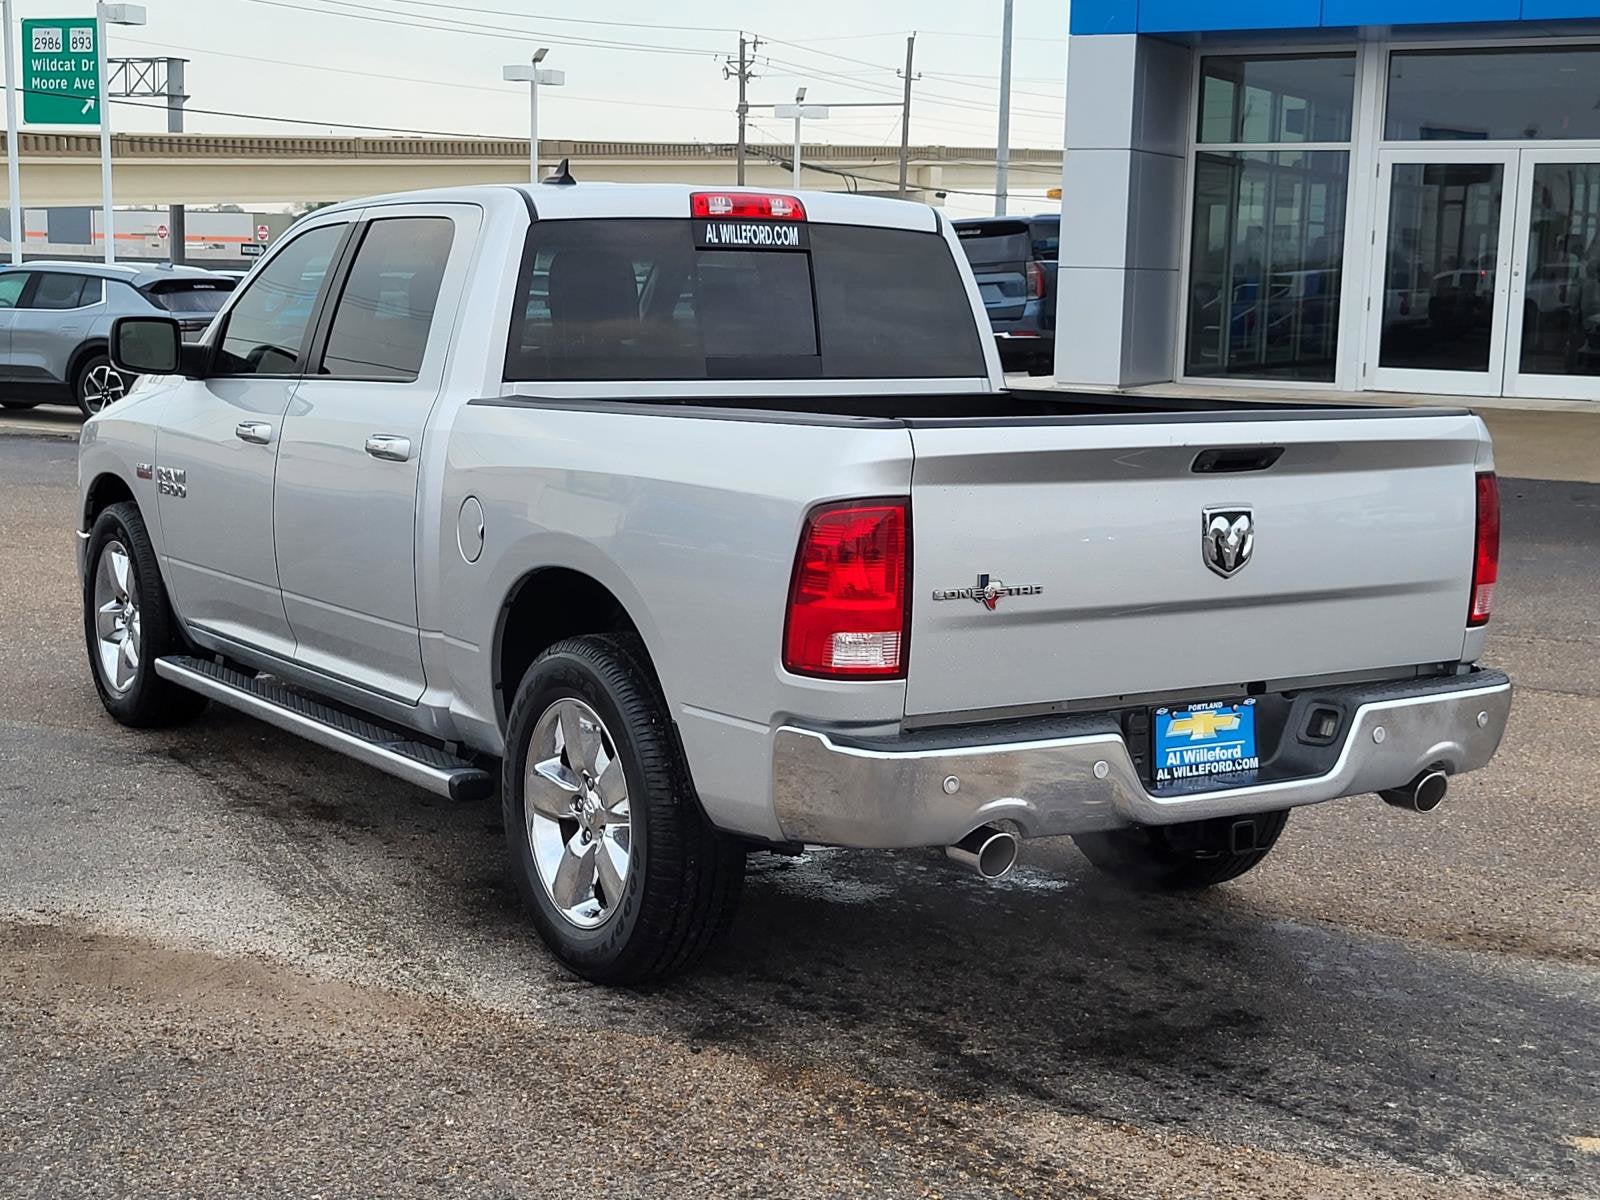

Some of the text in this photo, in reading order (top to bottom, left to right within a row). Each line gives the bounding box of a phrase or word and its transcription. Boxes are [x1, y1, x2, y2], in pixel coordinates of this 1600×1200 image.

[33, 36, 62, 50] 2986
[71, 36, 92, 50] 893
[31, 58, 95, 71] Wildcat Dr
[31, 77, 95, 89] Moore Ave
[705, 223, 799, 246] AL WILLEFORD.COM
[157, 466, 186, 483] RAM
[157, 479, 186, 499] 1500
[932, 584, 1044, 601] LONE STAR
[1187, 701, 1223, 712] PORTLAND
[1166, 744, 1242, 766] Al Willeford
[1156, 768, 1171, 781] AL
[1173, 757, 1259, 779] WILLEFORD.COM
